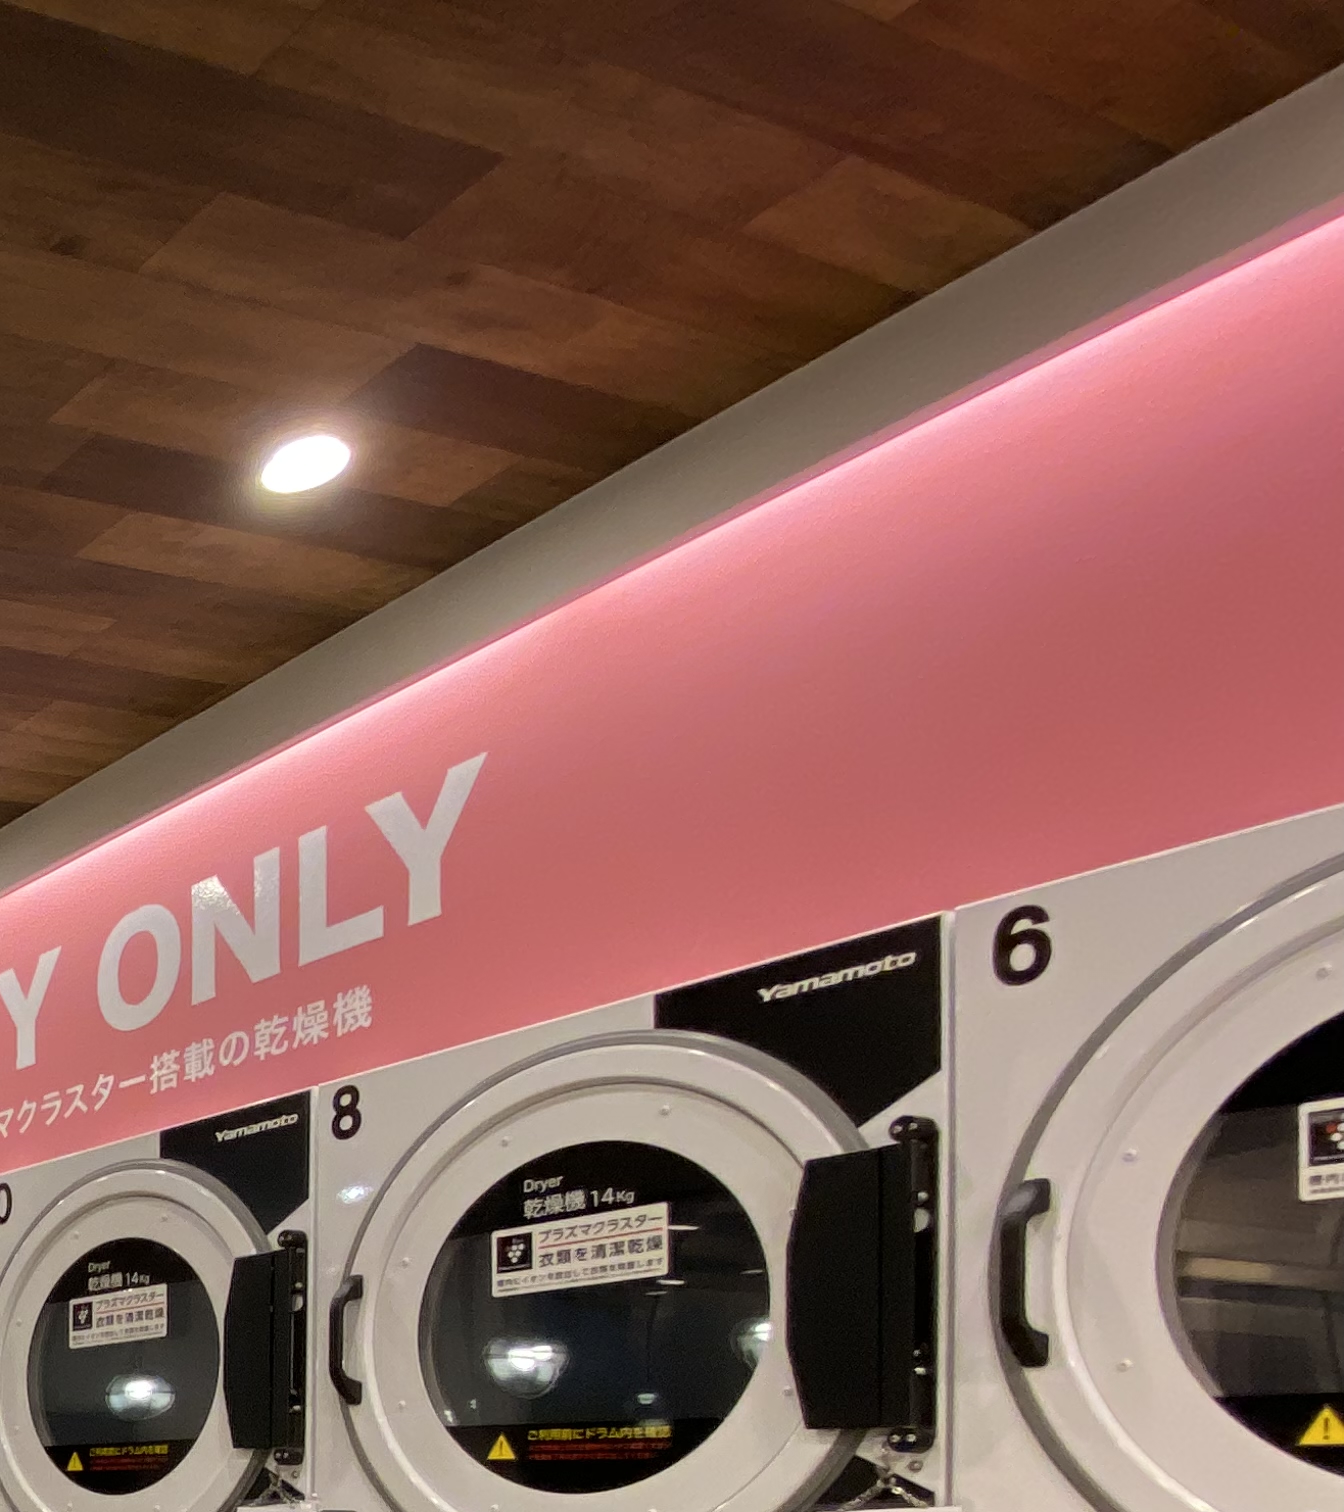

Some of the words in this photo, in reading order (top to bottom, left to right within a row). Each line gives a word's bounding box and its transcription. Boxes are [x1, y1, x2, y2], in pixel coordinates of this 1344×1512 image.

[97, 751, 489, 1032] ONLY
[993, 904, 1052, 987] 6
[757, 950, 917, 1003] Yamamoto
[215, 1113, 299, 1143] Yamamoto
[331, 1084, 362, 1140] 8
[523, 1175, 563, 1194] Dryer
[537, 1213, 663, 1243] プラズマクラスター
